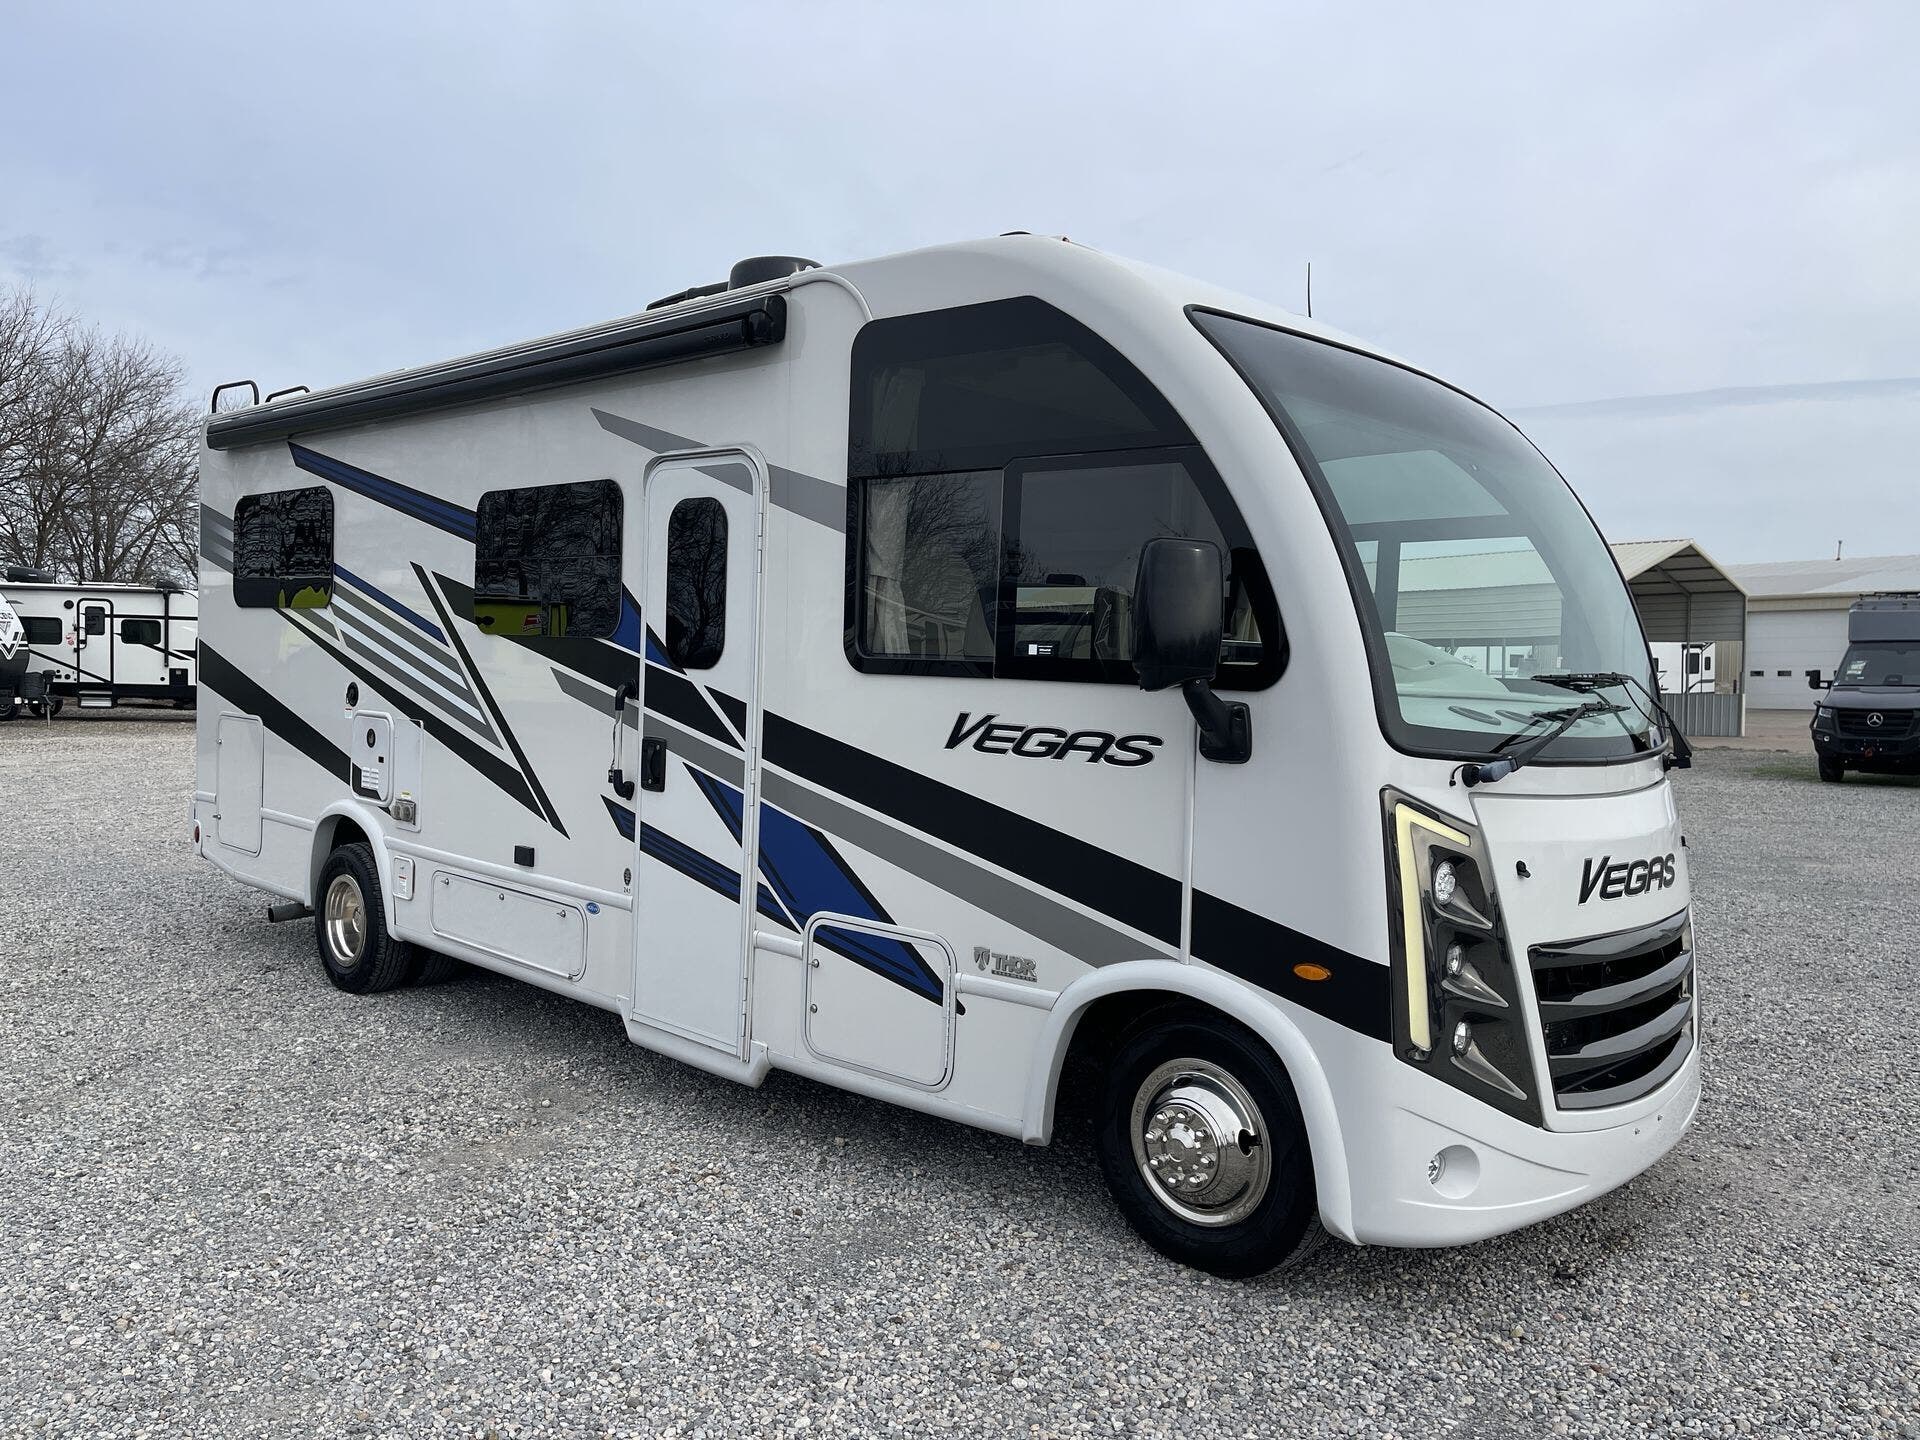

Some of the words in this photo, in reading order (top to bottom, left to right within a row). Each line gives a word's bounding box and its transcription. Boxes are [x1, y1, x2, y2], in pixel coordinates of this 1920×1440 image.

[944, 712, 1164, 768] VEGAS
[1578, 853, 1675, 906] VEGAS
[991, 952, 1036, 977] THOR
